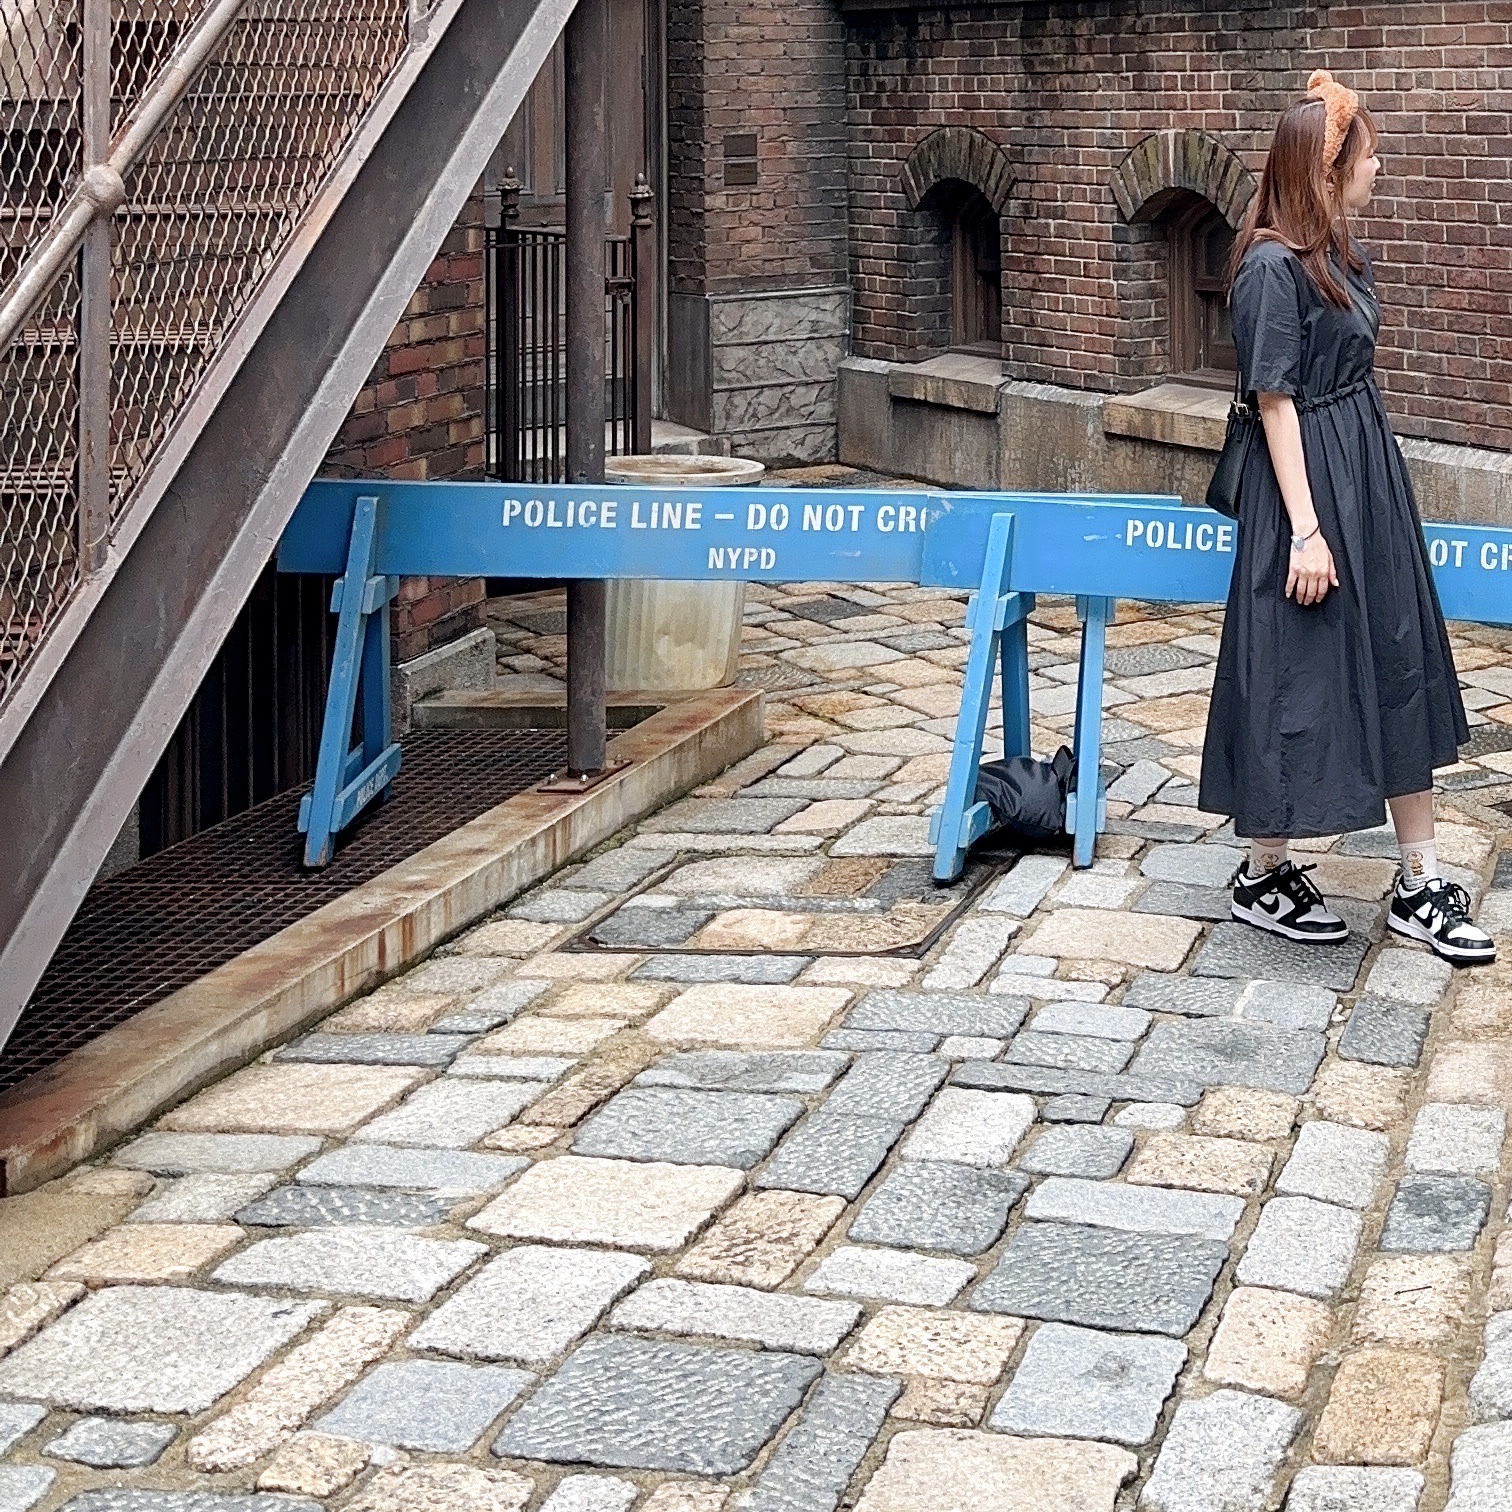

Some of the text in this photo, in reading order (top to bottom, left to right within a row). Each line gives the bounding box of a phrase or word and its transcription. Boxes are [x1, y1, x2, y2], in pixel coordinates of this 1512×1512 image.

[502, 499, 617, 528] POLICE
[630, 501, 702, 530] LINE
[746, 503, 789, 531] DO
[802, 504, 865, 532] NOT
[708, 547, 776, 570] NYPD
[1126, 519, 1233, 552] POLICE
[1429, 538, 1469, 568] OT
